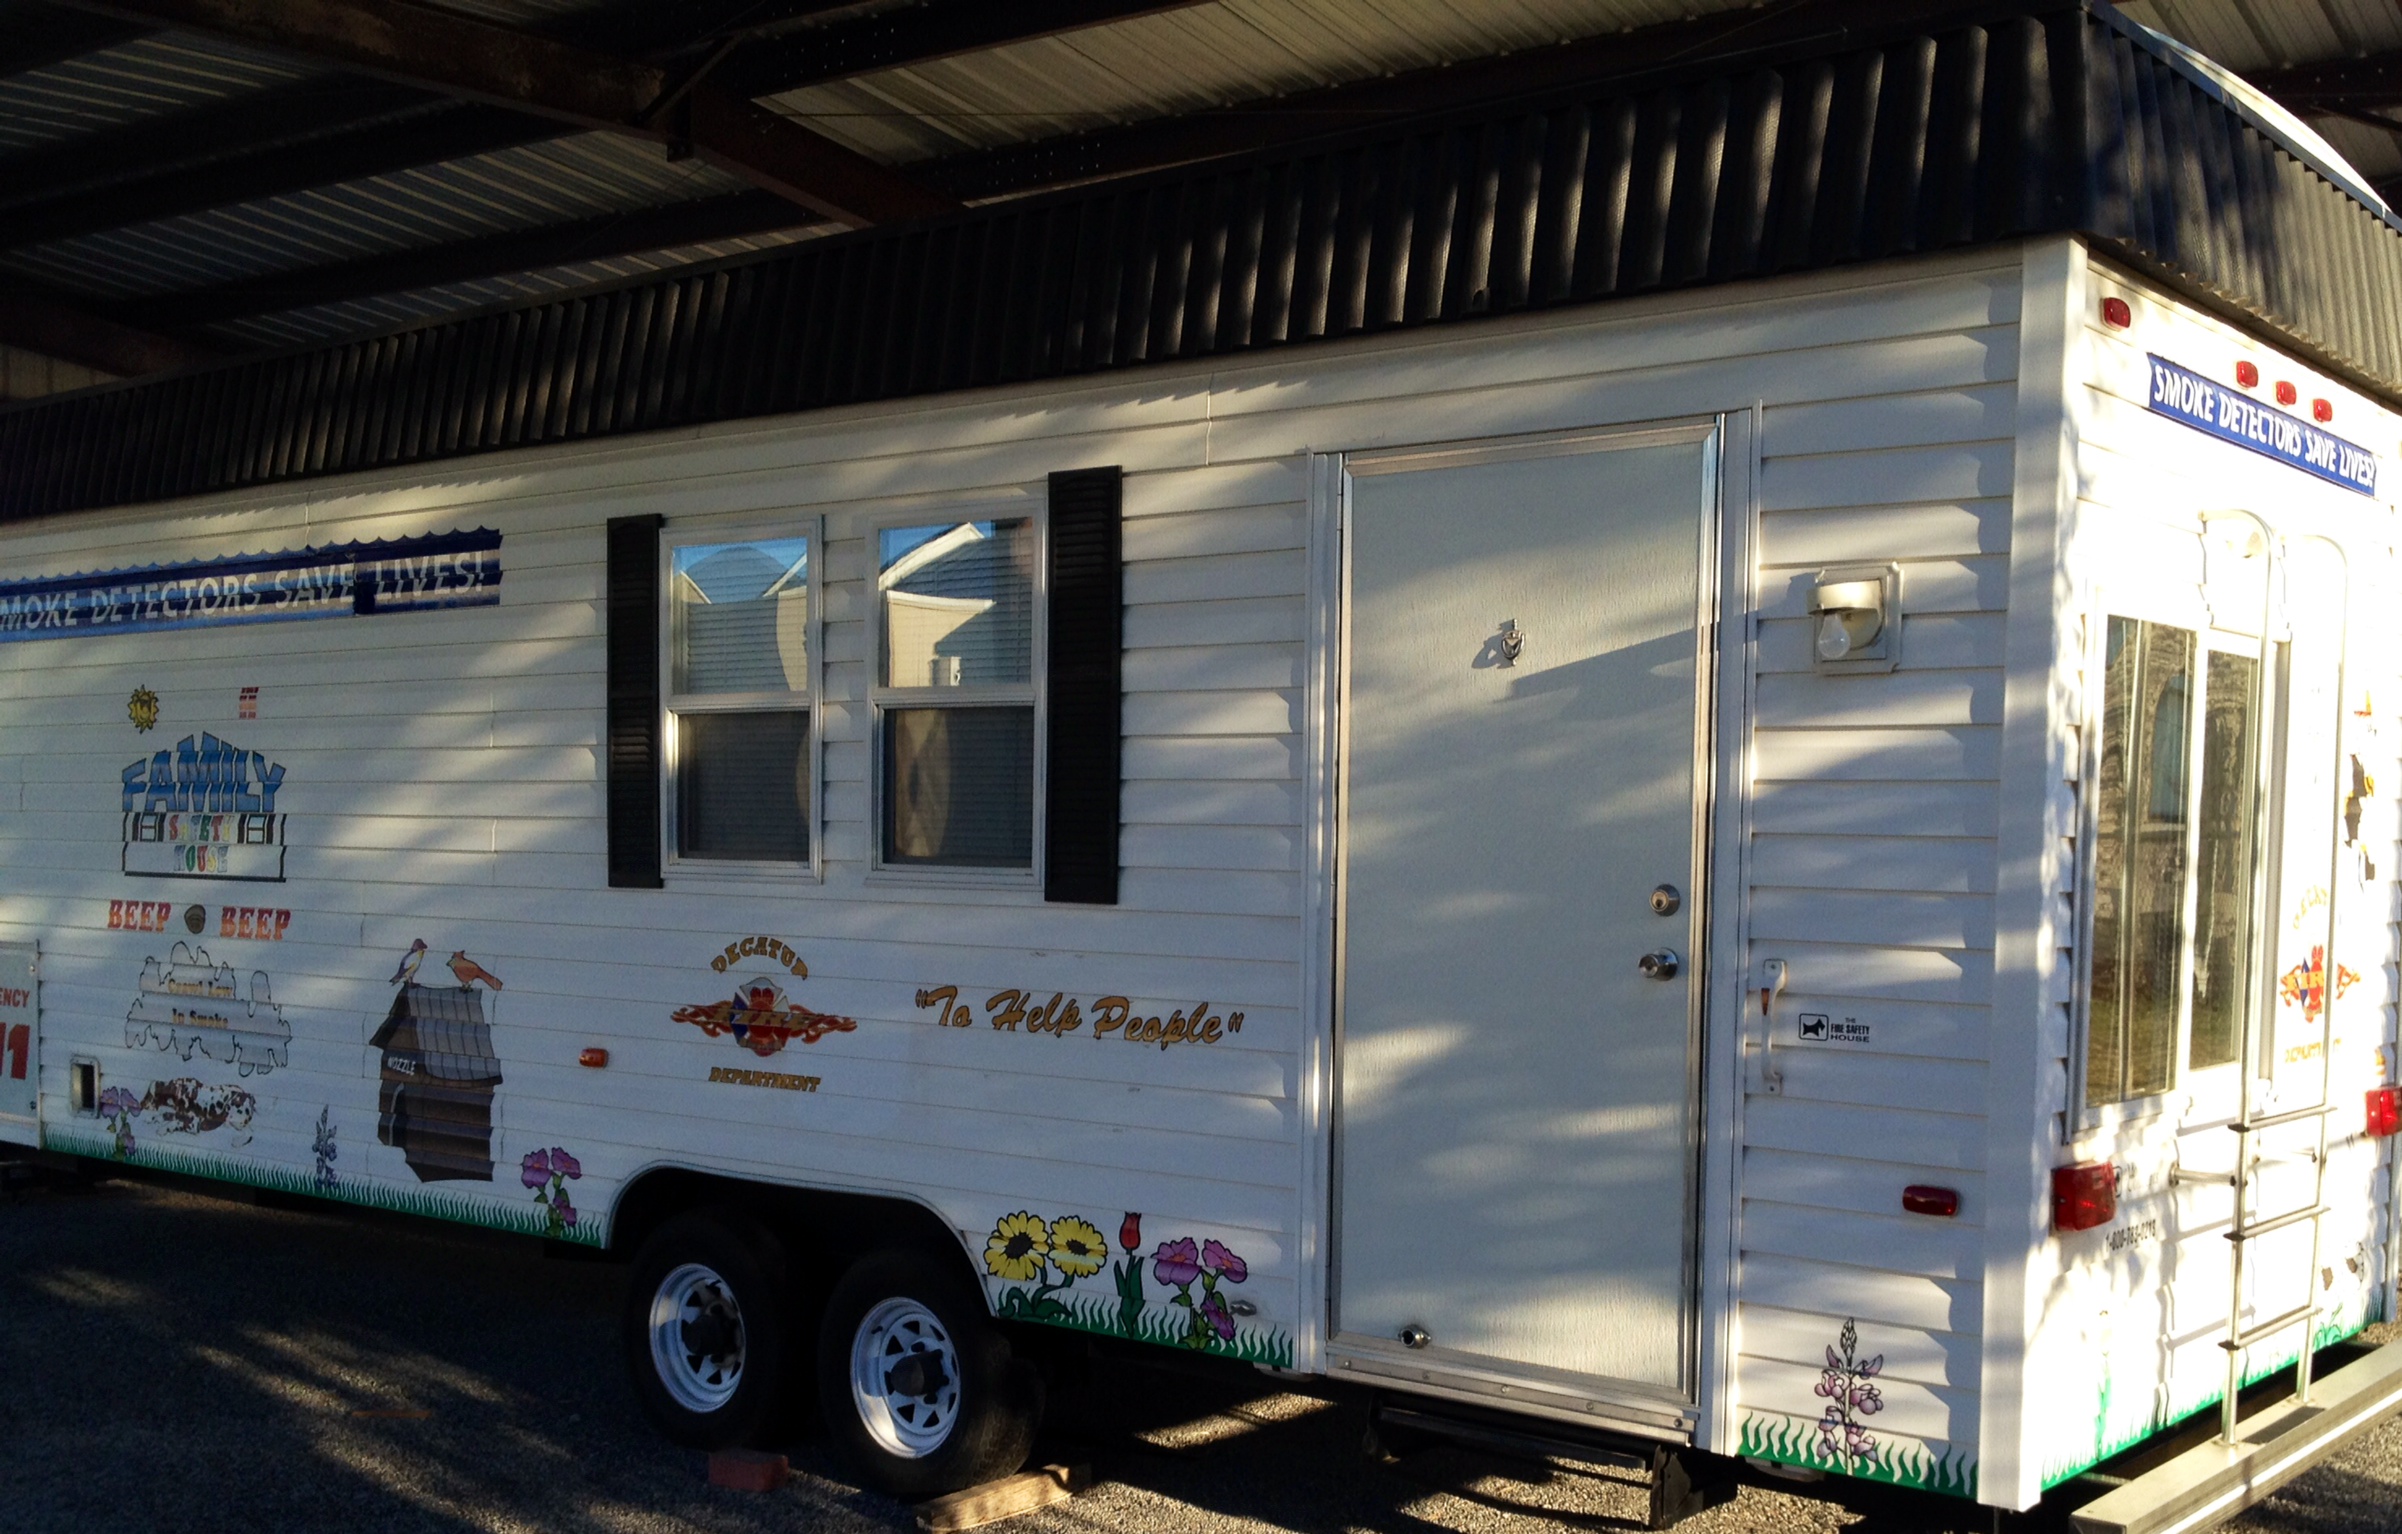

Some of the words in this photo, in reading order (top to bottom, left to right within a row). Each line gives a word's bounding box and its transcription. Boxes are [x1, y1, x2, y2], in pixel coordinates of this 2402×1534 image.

[2154, 364, 2214, 422] SMOKE
[2218, 391, 2302, 457] DETECTORS
[2304, 429, 2336, 473] SAVE
[2338, 444, 2376, 488] LIVES!
[0, 592, 78, 631] MOKE
[90, 572, 258, 625] DETECTORS
[274, 561, 355, 604] SAVE
[374, 550, 484, 600] LIVES!
[122, 731, 287, 812] FAMILY
[168, 814, 235, 842] SAFETY
[173, 845, 229, 873] HOUSE
[108, 899, 172, 933] BEEP
[220, 906, 291, 940] BEEP
[710, 936, 809, 980] DECATUR
[172, 1008, 185, 1025] In
[189, 1010, 229, 1029] Smoke
[985, 988, 1083, 1038] Help
[1830, 1023, 1845, 1034] FIRE
[1845, 1024, 1870, 1035] SAFETY
[1830, 1034, 1869, 1042] HOUSE
[387, 1055, 417, 1076] NOZZLE
[708, 1066, 821, 1093] DEPARTMENT
